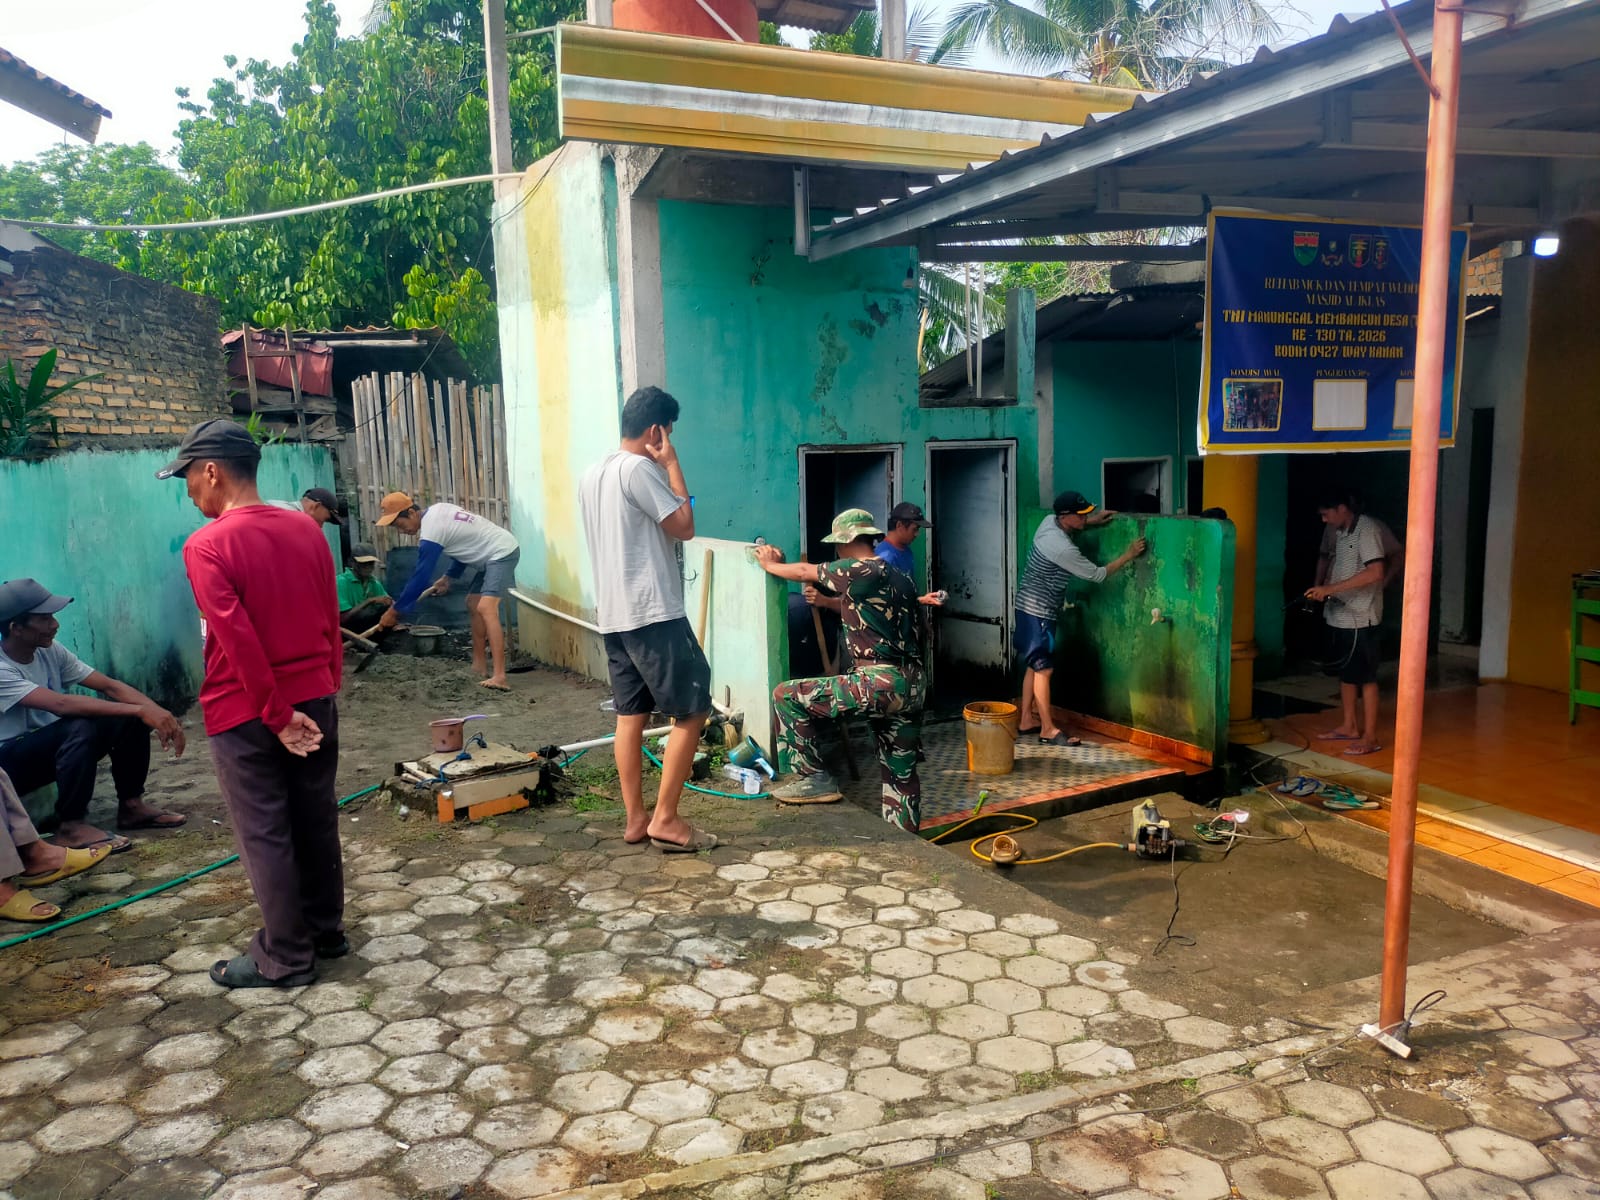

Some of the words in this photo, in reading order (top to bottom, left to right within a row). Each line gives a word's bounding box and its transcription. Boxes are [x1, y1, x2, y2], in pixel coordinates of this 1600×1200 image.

[1222, 309, 1246, 323] TNI
[1247, 310, 1313, 325] MANUNGGAL
[1315, 312, 1381, 326] MEMBANGUN
[1383, 313, 1409, 327] DESA
[1292, 328, 1307, 341] KE
[1315, 328, 1336, 342] 130
[1338, 329, 1357, 342] TA.
[1358, 329, 1387, 342] 2026
[1274, 344, 1307, 358] KODIM
[1309, 344, 1339, 358] 0427
[1342, 345, 1367, 359] WAY
[1368, 346, 1404, 359] KANAN
